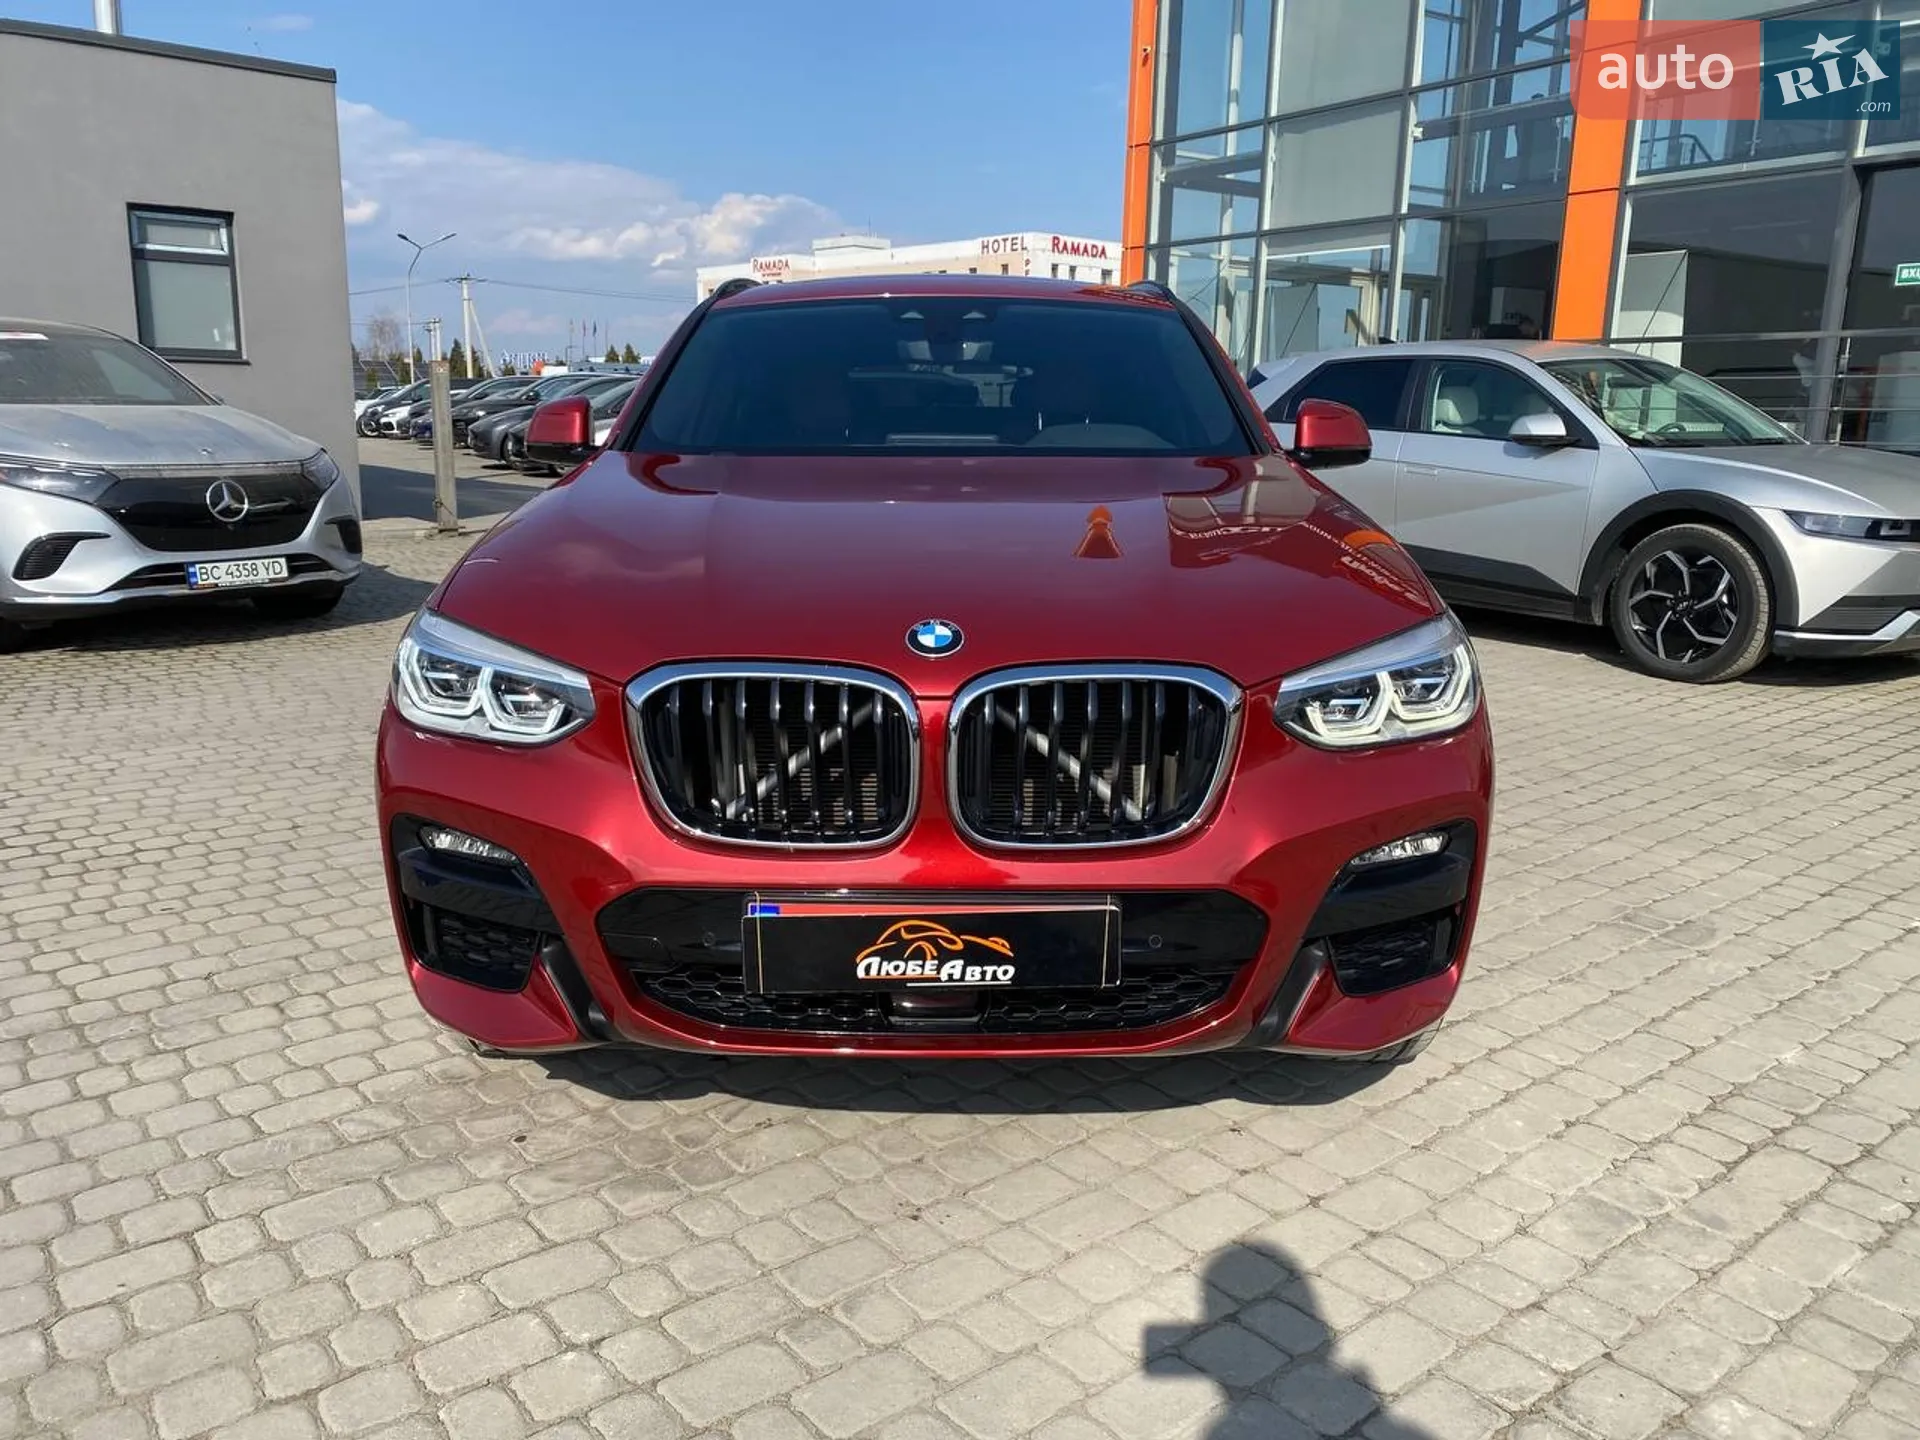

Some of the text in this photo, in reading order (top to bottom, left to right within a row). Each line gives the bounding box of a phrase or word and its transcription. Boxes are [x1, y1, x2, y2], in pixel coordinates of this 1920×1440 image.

[981, 236, 1027, 254] HOTEL
[1051, 236, 1107, 259] RAMADA
[752, 259, 791, 273] RAMADA
[198, 560, 283, 581] BC 4358 YD
